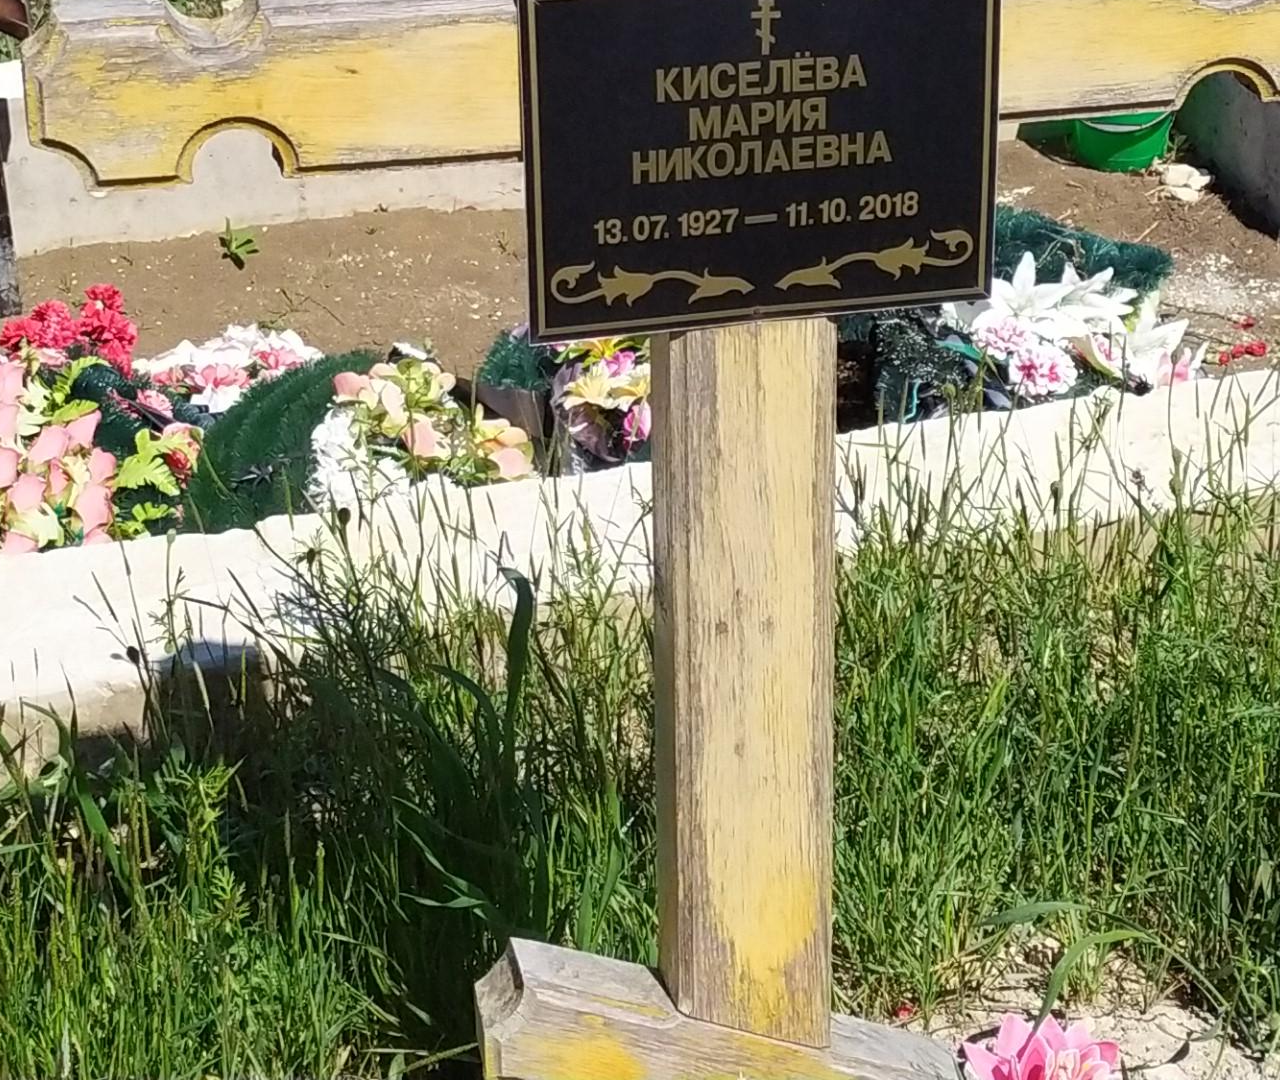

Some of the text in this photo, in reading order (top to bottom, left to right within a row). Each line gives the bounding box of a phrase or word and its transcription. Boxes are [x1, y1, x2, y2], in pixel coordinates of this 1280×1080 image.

[656, 51, 867, 103] КИСЕЛЁВА
[689, 97, 826, 142] МАРИЯ
[632, 130, 892, 185] НИКОЛАЕВНА
